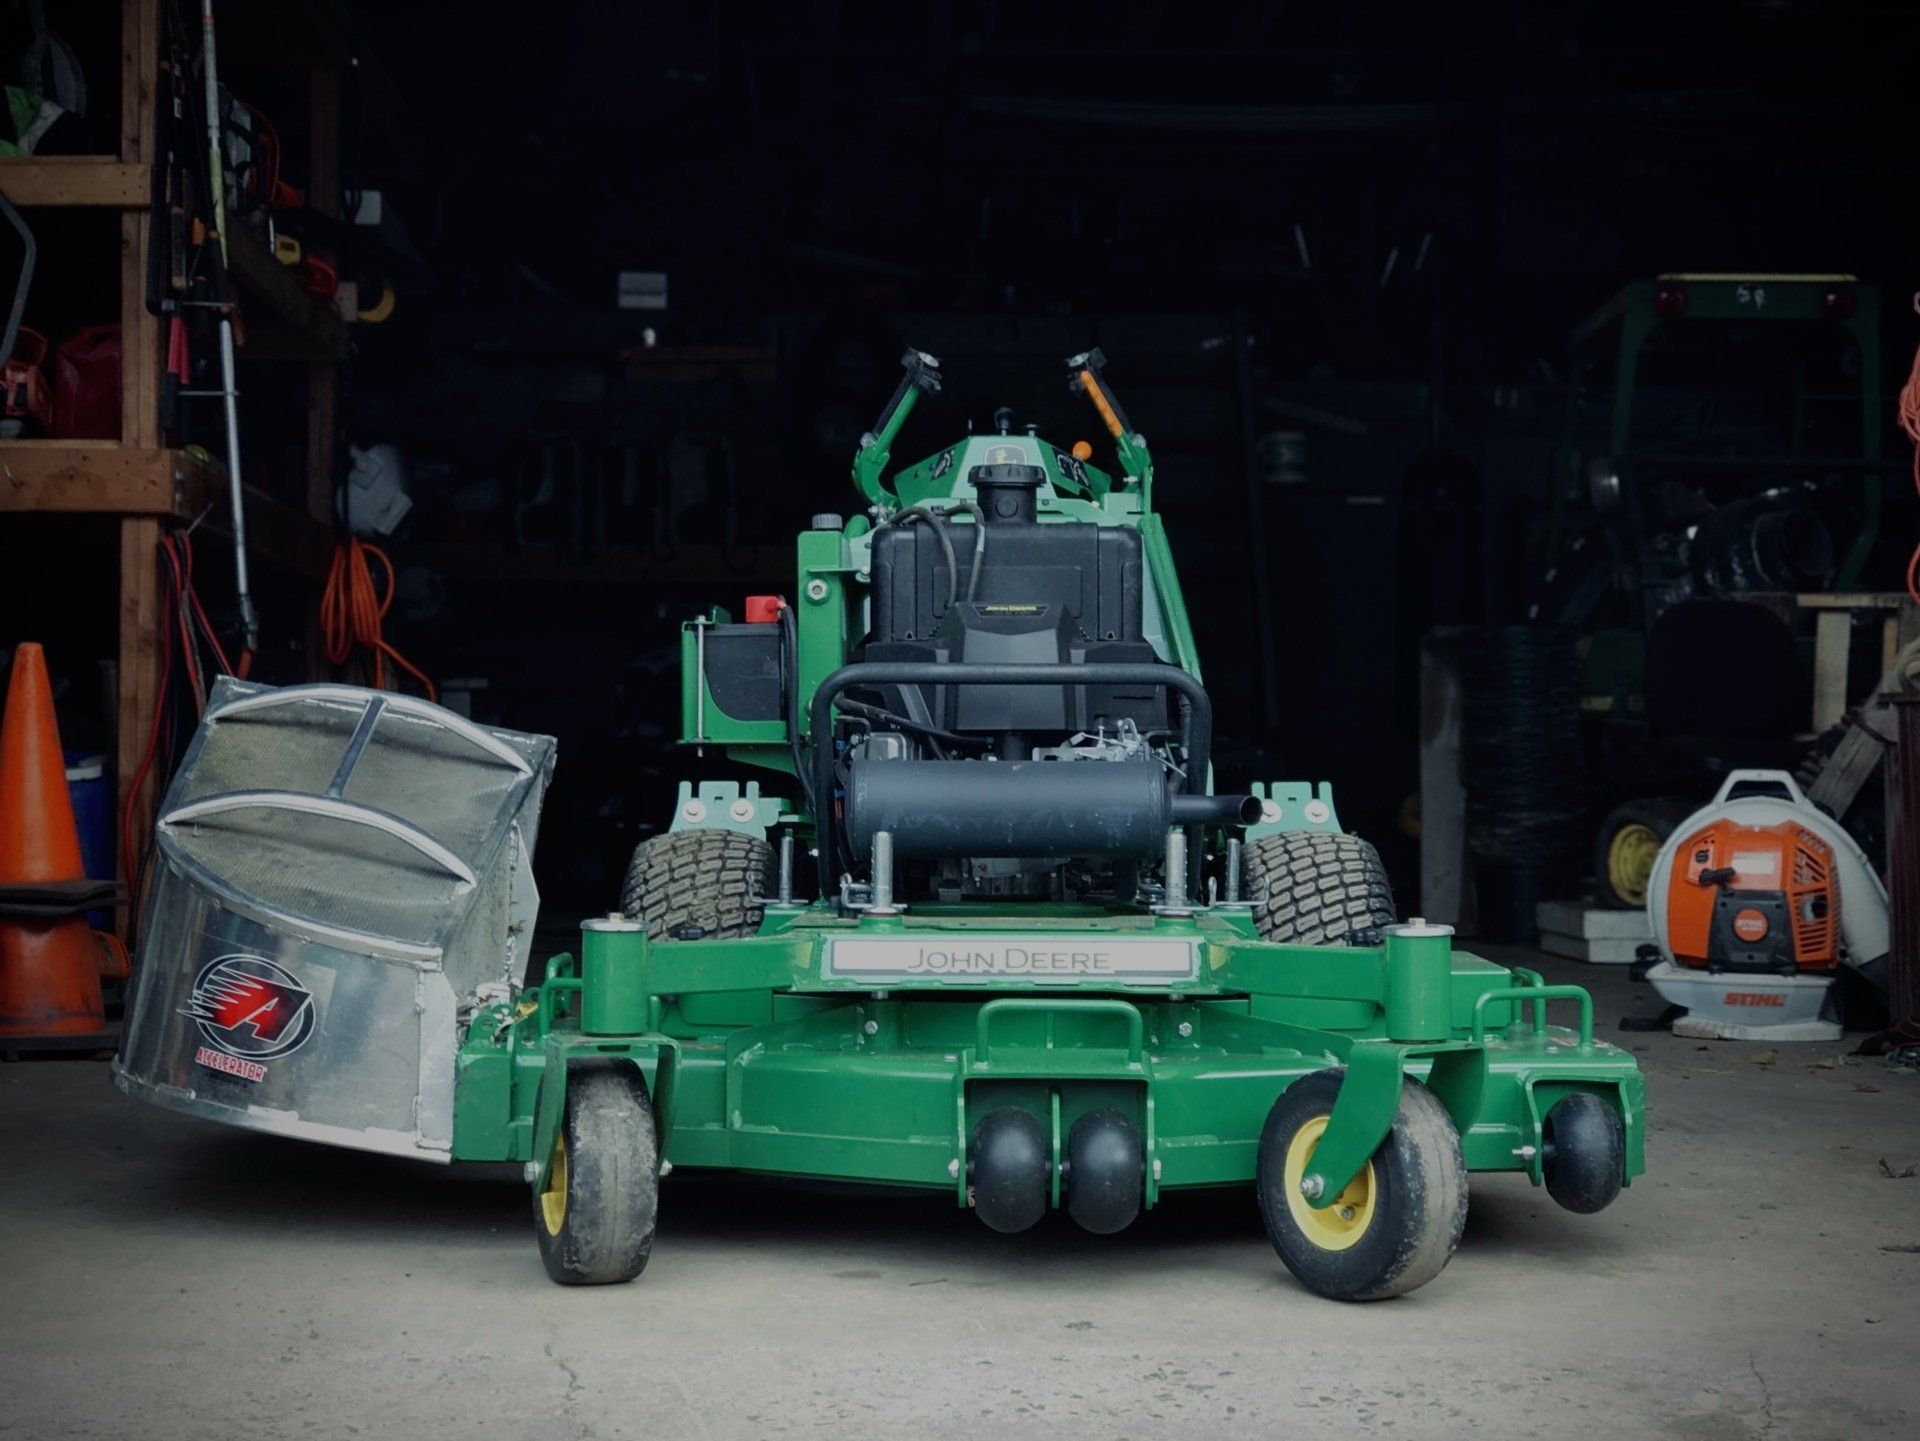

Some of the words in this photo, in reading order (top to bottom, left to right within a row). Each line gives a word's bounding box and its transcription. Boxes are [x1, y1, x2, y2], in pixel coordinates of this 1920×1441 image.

[908, 948, 994, 969] JOHN
[1005, 949, 1110, 969] DEERE
[1724, 993, 1784, 1007] STIHL
[195, 1047, 264, 1081] ACCELERATOR
